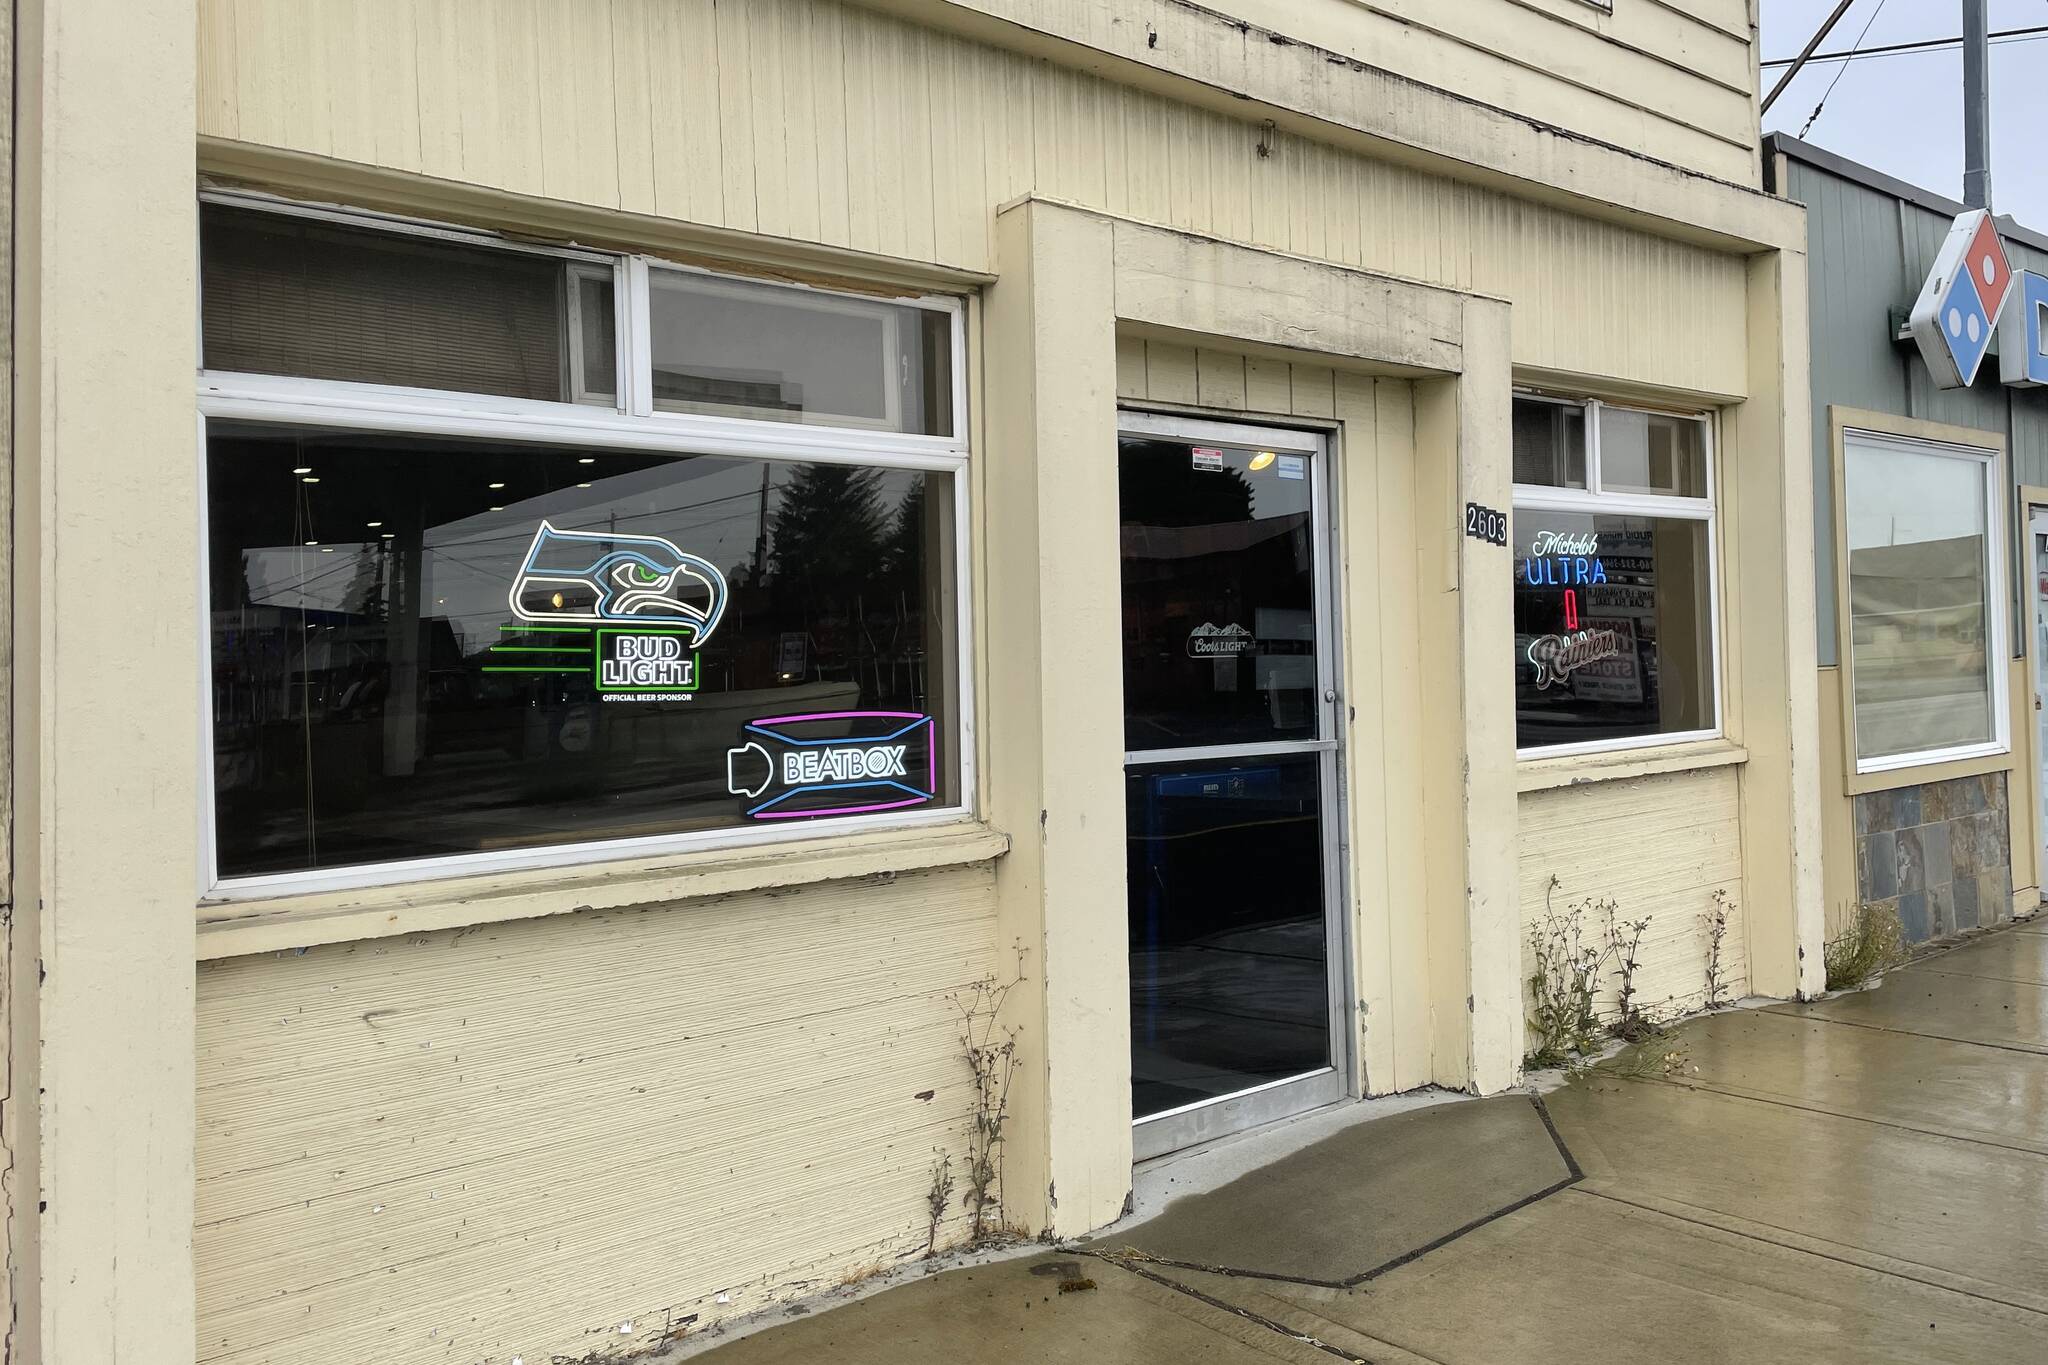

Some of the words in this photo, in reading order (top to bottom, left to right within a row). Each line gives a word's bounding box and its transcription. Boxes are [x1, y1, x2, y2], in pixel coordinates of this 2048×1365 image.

[1467, 506, 1506, 542] 2603
[1533, 530, 1598, 556] Michelob
[1526, 557, 1606, 585] ULTRA
[616, 636, 680, 660] BUD
[1194, 638, 1219, 653] Coors
[1220, 641, 1248, 652] LIGHT
[602, 660, 692, 685] LIGHT
[602, 694, 636, 702] OFFICIAL
[783, 745, 907, 784] BEATBOX
